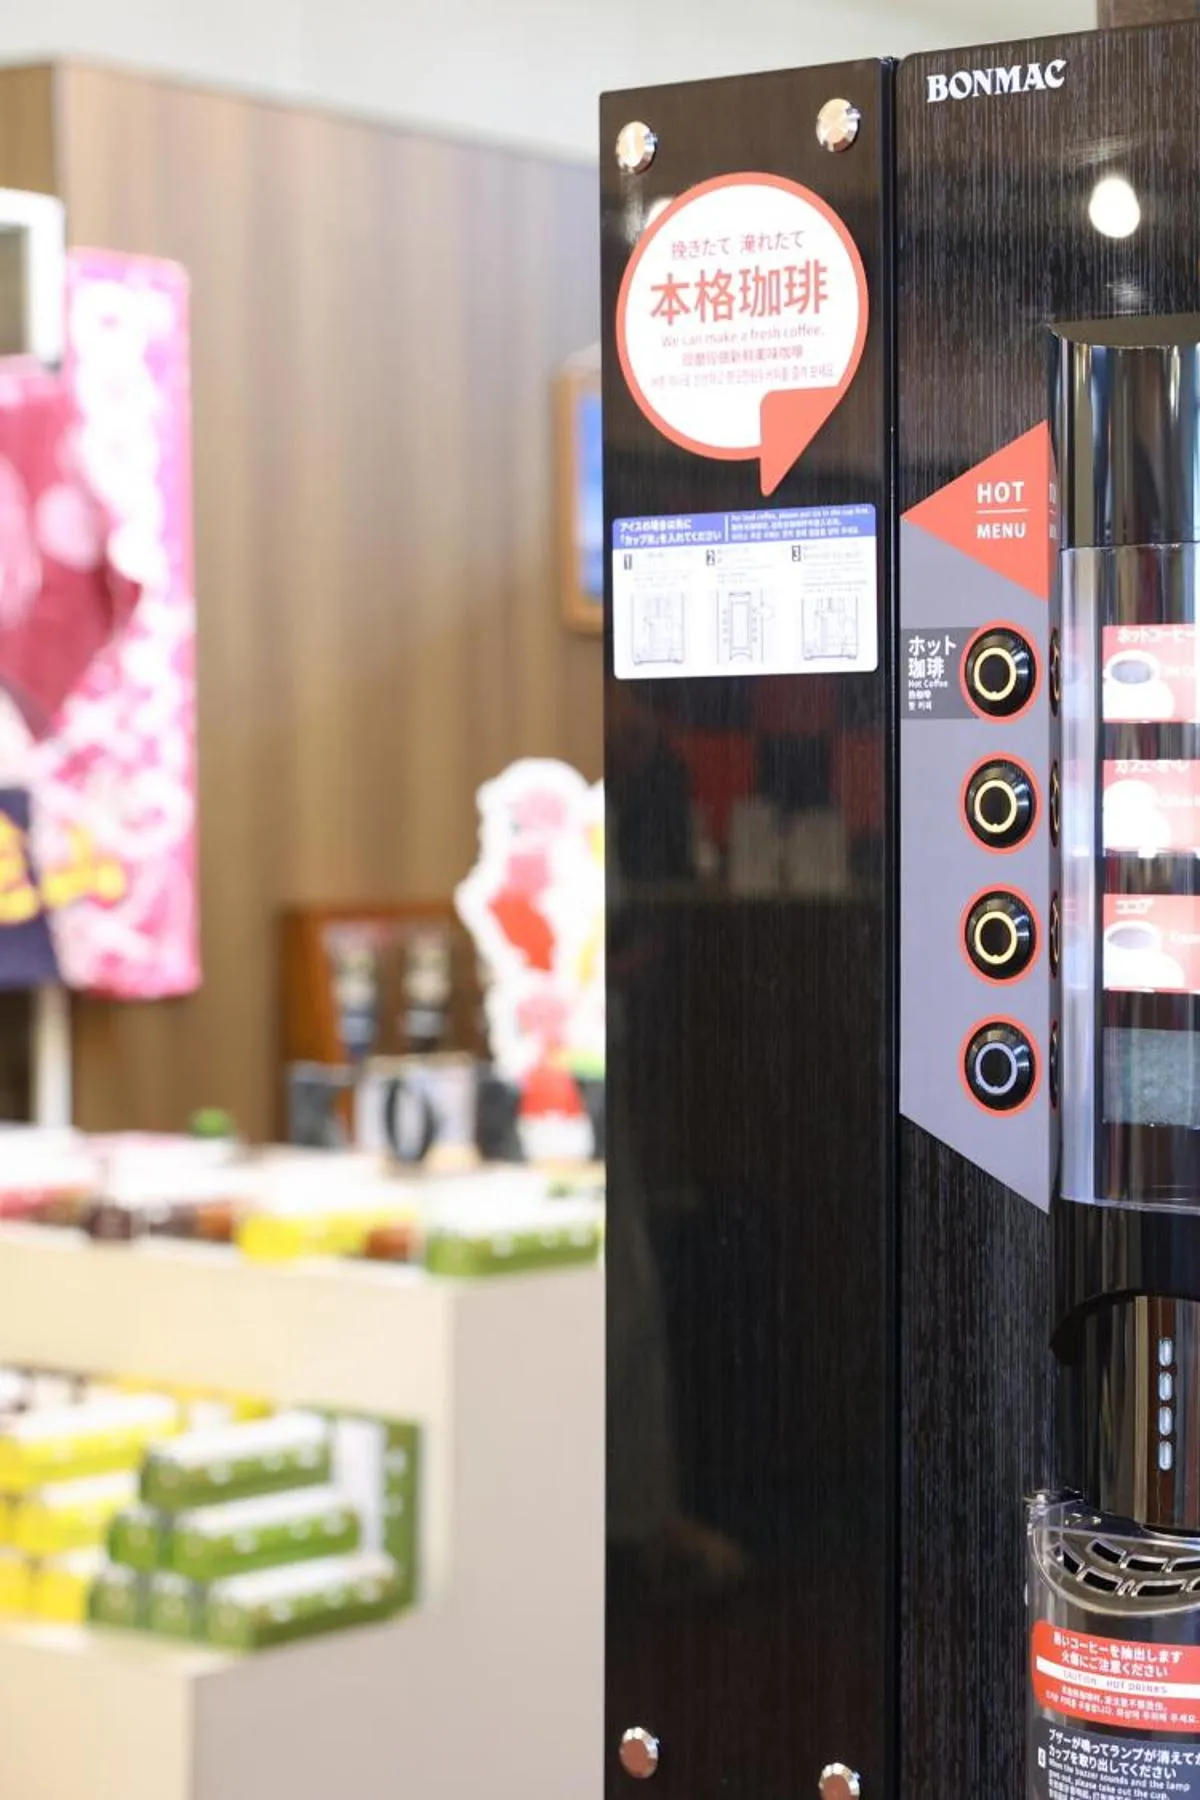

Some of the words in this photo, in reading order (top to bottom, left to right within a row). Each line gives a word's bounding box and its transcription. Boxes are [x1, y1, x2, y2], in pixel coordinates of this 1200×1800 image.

[927, 59, 1067, 103] BONMAC
[672, 236, 731, 261] 挽きたて
[740, 230, 806, 255] 淹れたて
[650, 259, 830, 327] 本格珈琲
[705, 329, 738, 345] make
[750, 325, 781, 342] fresh
[976, 481, 1025, 504] HOT
[976, 522, 1026, 540] MENU
[908, 635, 957, 656] ホット
[908, 656, 945, 678] 珈琲
[1062, 1669, 1097, 1686] CAUTION
[1107, 1679, 1125, 1691] HOT
[1128, 1682, 1168, 1695] DRINKS
[1049, 1744, 1177, 1779] カップを取り出してください
[1134, 1787, 1149, 1798] the
[1149, 1779, 1165, 1790] the
[1166, 1780, 1191, 1793] lamp
